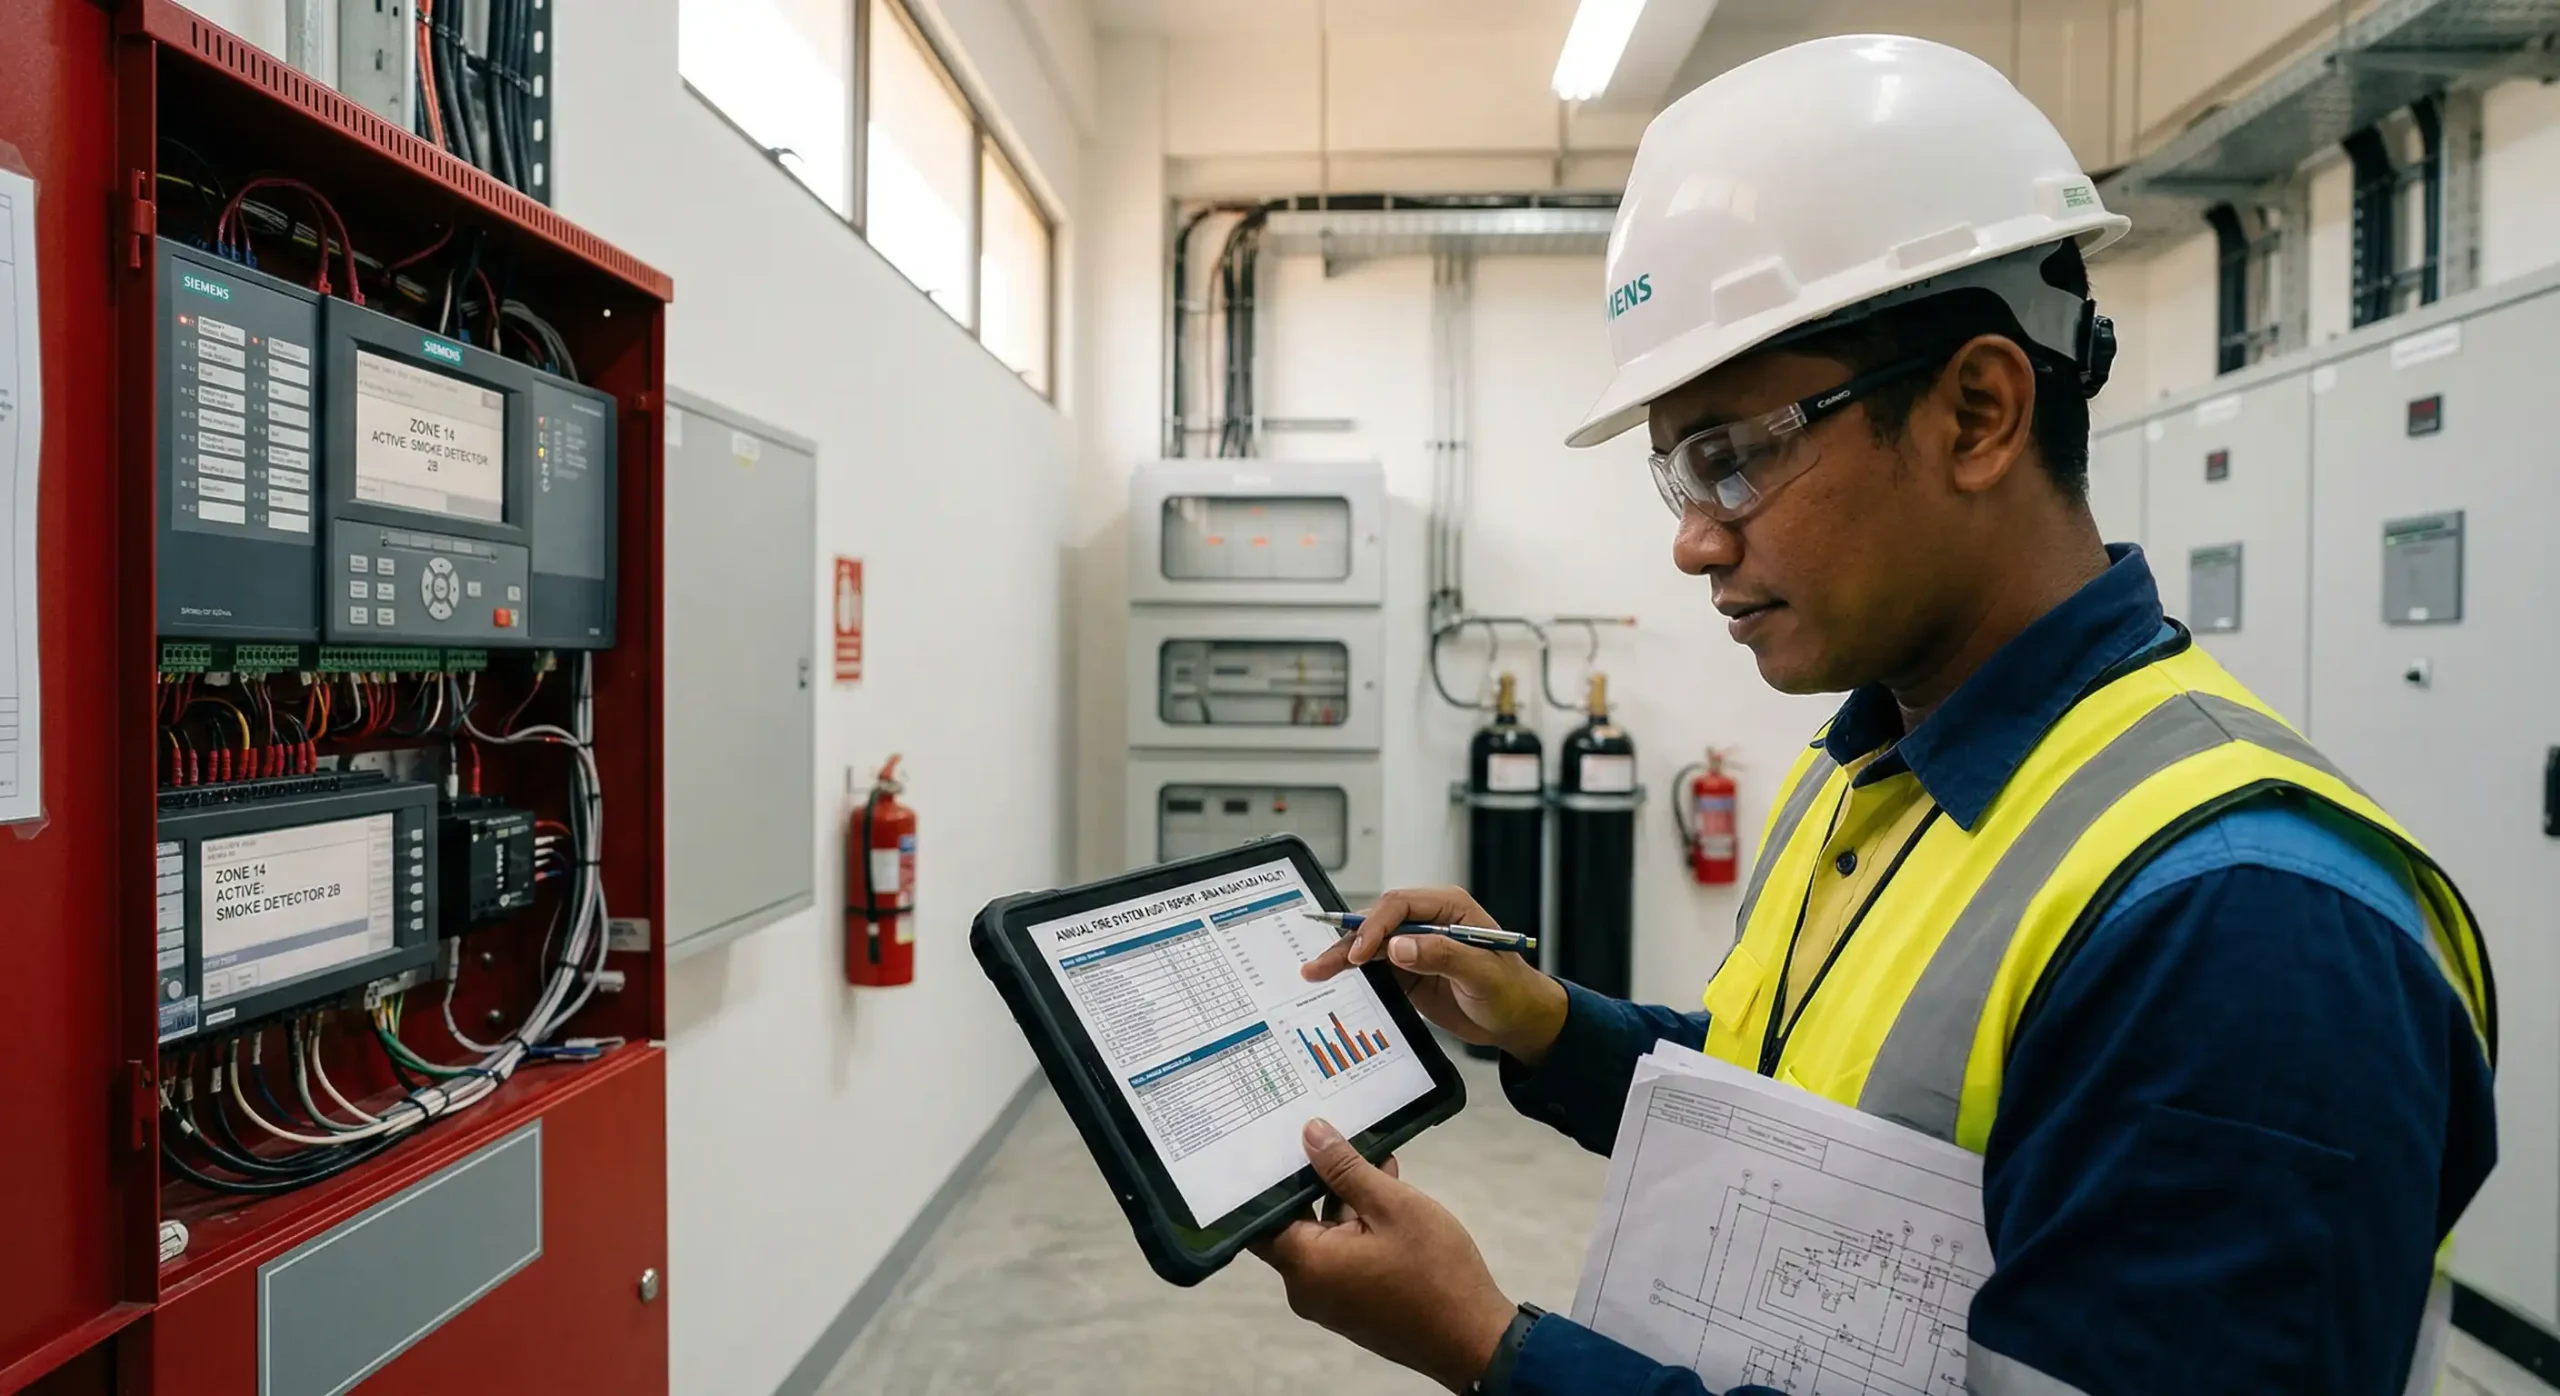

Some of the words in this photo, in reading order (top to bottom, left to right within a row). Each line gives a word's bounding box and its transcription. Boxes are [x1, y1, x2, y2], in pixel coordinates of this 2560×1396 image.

[184, 275, 230, 300] SIEMENS
[424, 340, 461, 362] SIEMENS
[409, 418, 440, 439] ZONE
[443, 427, 455, 442] 14
[410, 438, 442, 457] SMOKE
[443, 446, 489, 466] DETECTOR
[427, 459, 439, 472] 2B
[215, 865, 250, 884] ZONE
[253, 863, 267, 877] 14
[216, 882, 265, 903] ACTIVE:
[216, 900, 261, 922] SMOKE
[264, 886, 325, 912] DETECTOR
[327, 883, 341, 898] 2B
[1055, 922, 1093, 942] ANNUAL
[1091, 916, 1113, 931] FIRE
[1111, 907, 1144, 926] SYSTEM
[1144, 901, 1168, 917] AUDIT
[1166, 893, 1200, 910] REPORT
